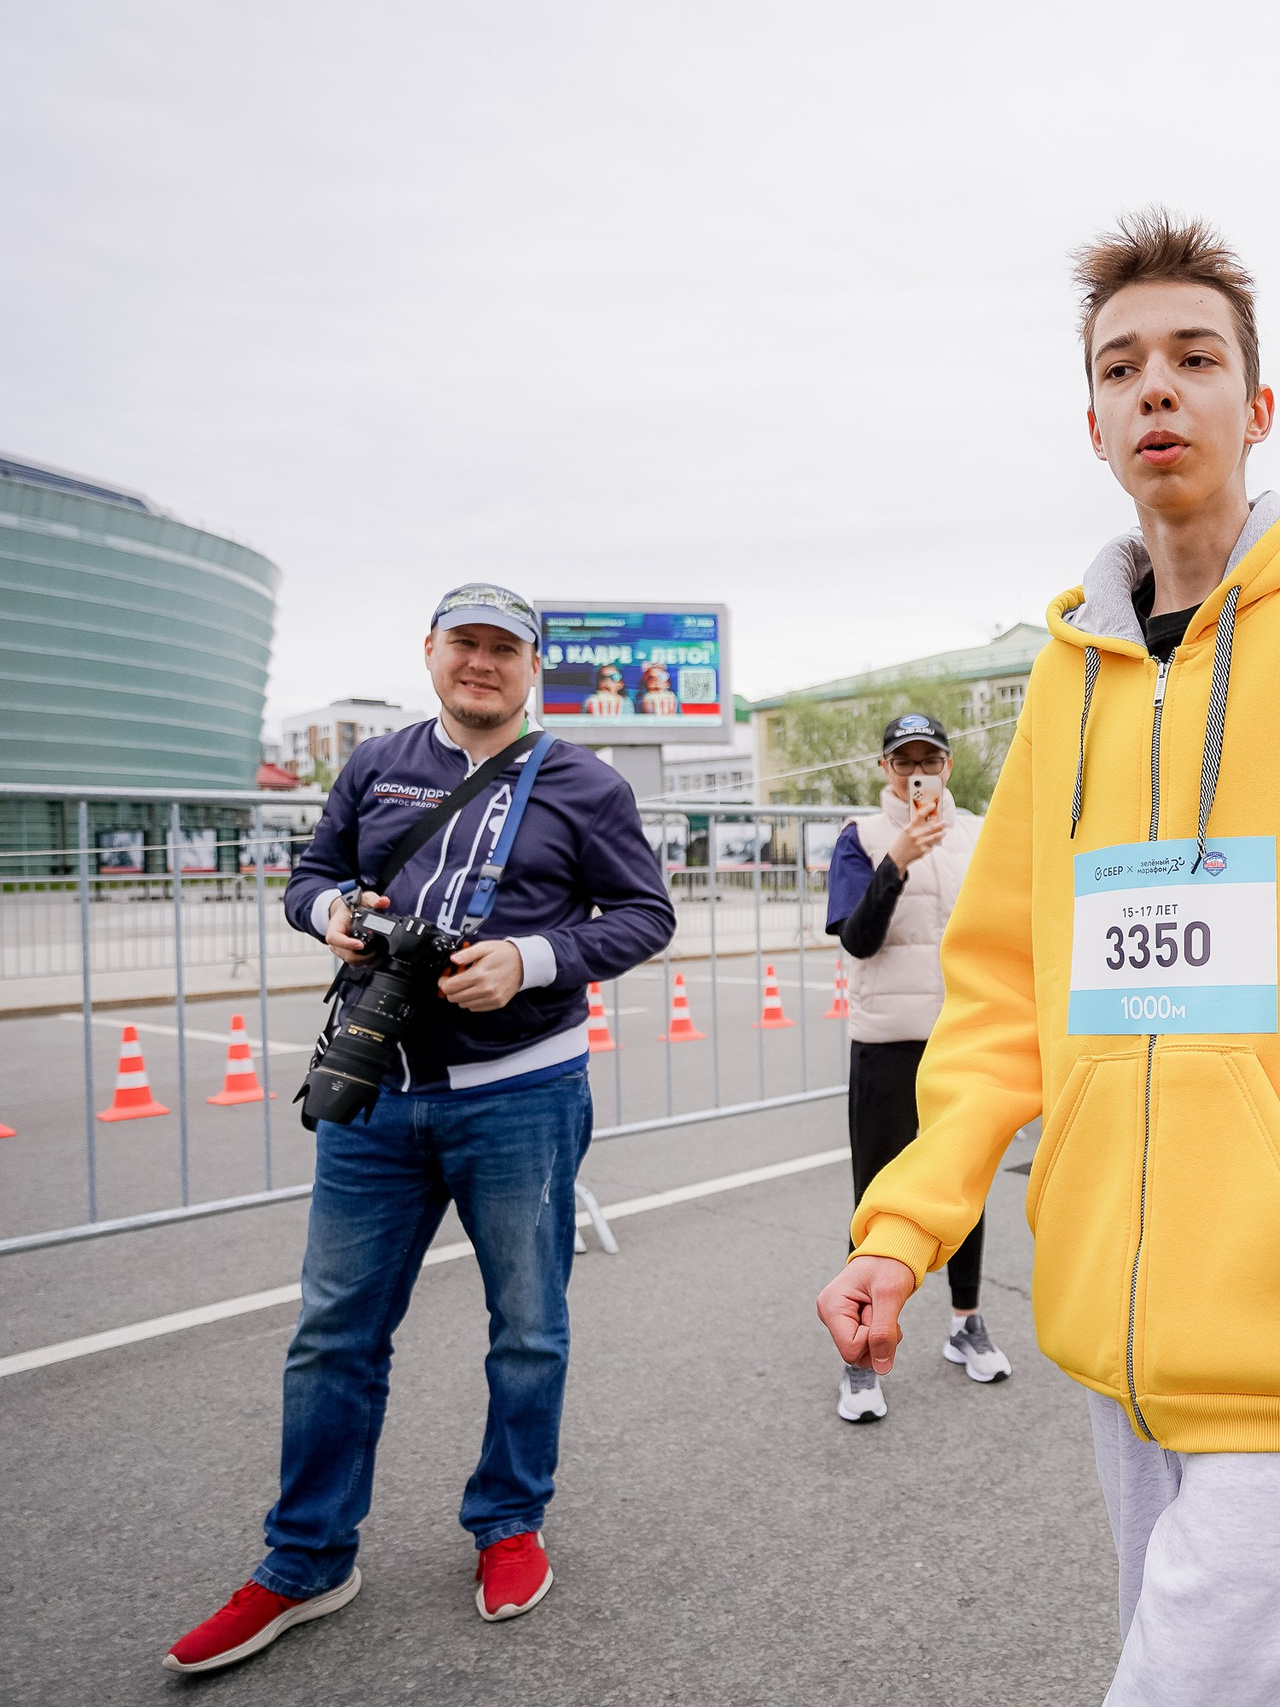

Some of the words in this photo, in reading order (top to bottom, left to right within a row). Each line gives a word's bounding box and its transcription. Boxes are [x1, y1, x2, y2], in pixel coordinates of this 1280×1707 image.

[566, 645, 632, 666] КАДРЕ
[1140, 858, 1170, 867] зелёный
[1103, 866, 1124, 877] СБЕР
[1137, 867, 1167, 875] марафон
[1122, 906, 1152, 918] 15-17
[1156, 904, 1178, 916] ЛЕТ
[1106, 920, 1211, 970] 3350
[1121, 995, 1186, 1020] 1000м
